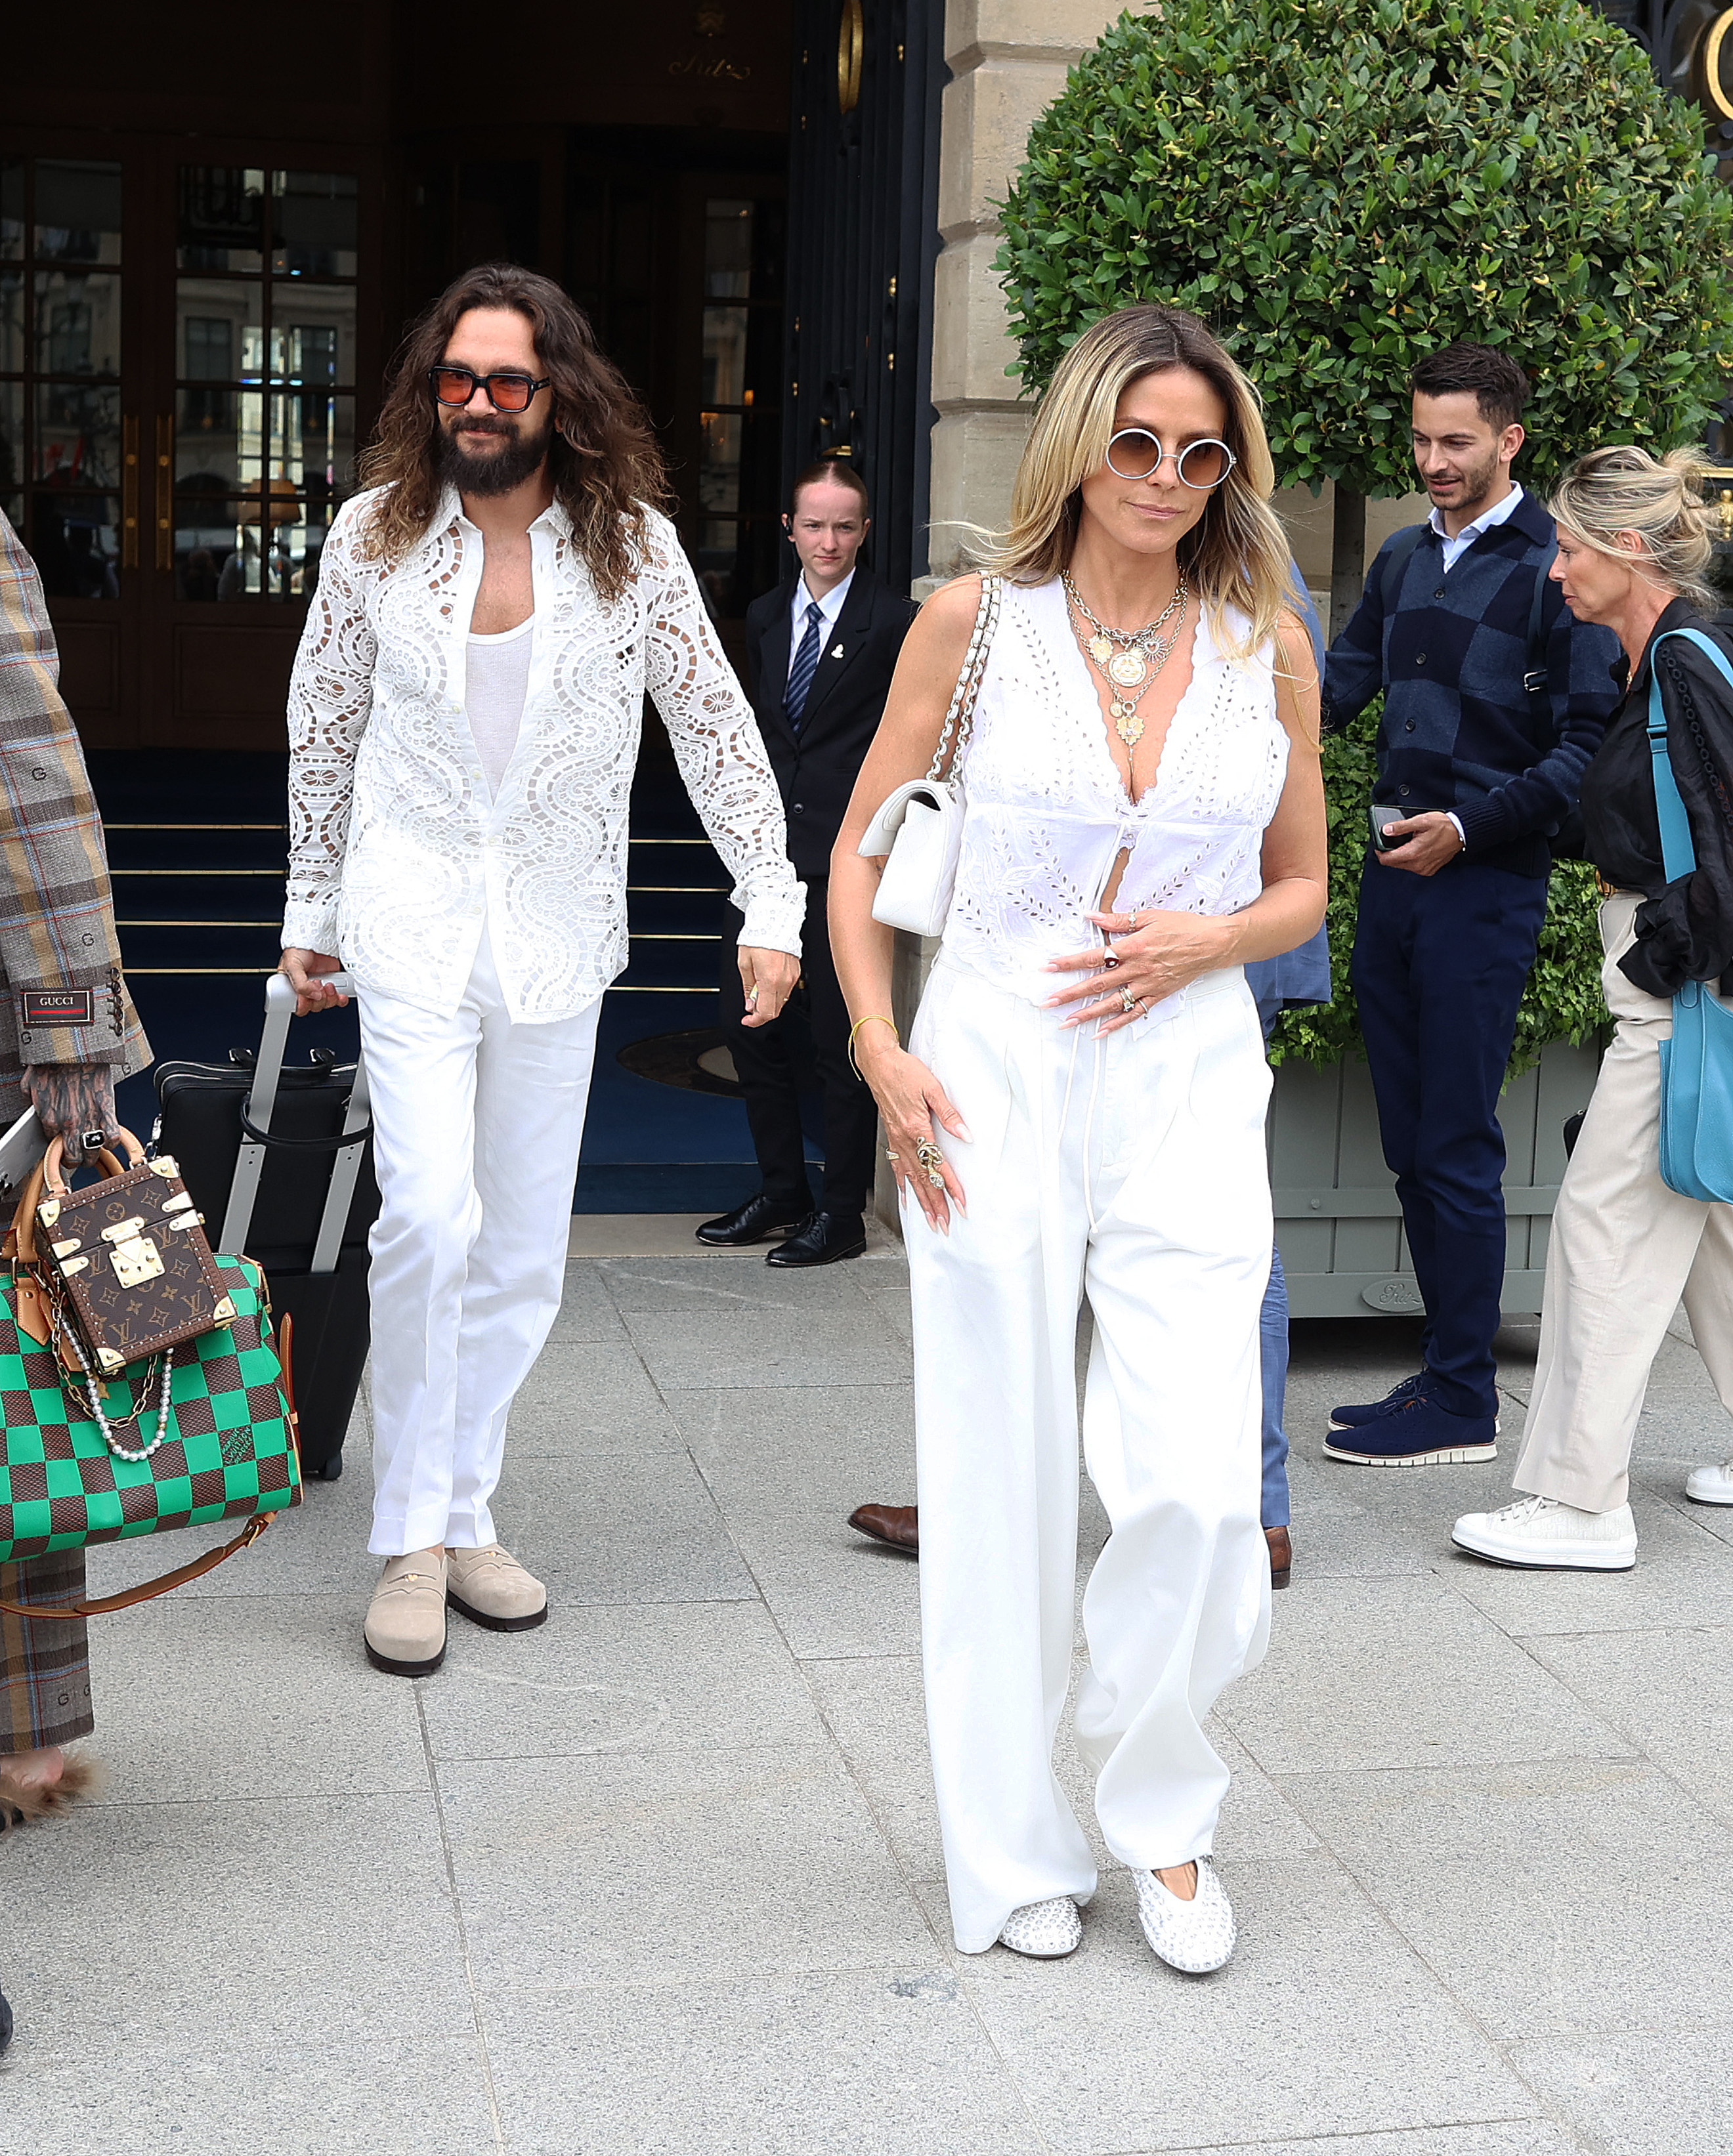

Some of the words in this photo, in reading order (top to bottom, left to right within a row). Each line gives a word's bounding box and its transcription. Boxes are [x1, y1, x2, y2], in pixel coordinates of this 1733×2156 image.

[33, 767, 47, 781] G
[81, 933, 95, 946] G
[39, 996, 74, 1005] GUCCI
[20, 1031, 32, 1045] G
[181, 1289, 208, 1319] LV
[108, 1318, 137, 1346] LV
[222, 1427, 240, 1454] MARQUE
[58, 1693, 69, 1706] G
